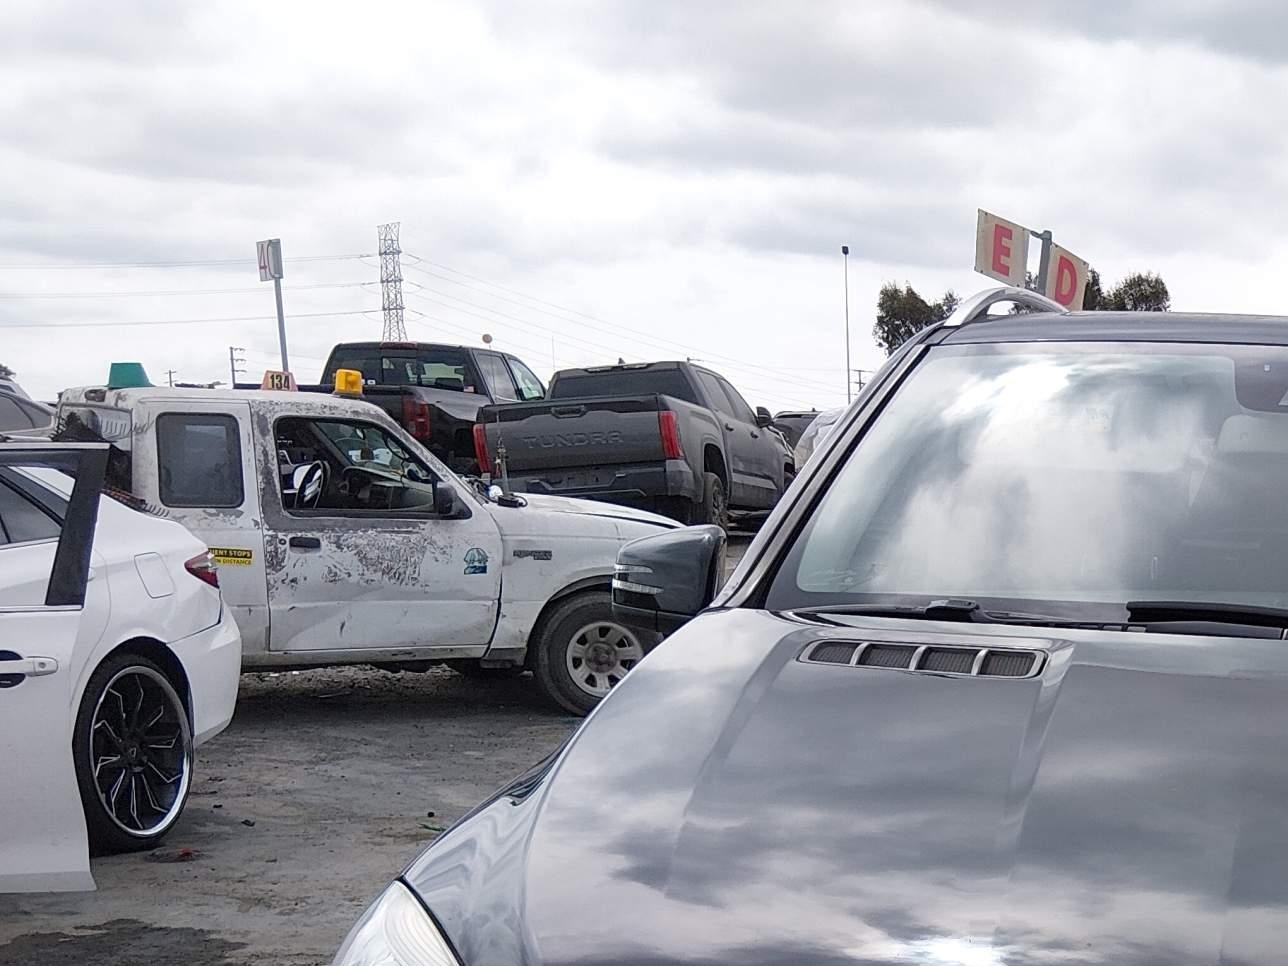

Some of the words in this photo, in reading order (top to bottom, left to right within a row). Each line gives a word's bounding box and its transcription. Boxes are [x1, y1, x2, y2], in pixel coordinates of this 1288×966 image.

[992, 224, 1013, 277] E
[1055, 255, 1077, 306] D
[270, 374, 290, 390] 134
[522, 430, 624, 449] TUNDRA
